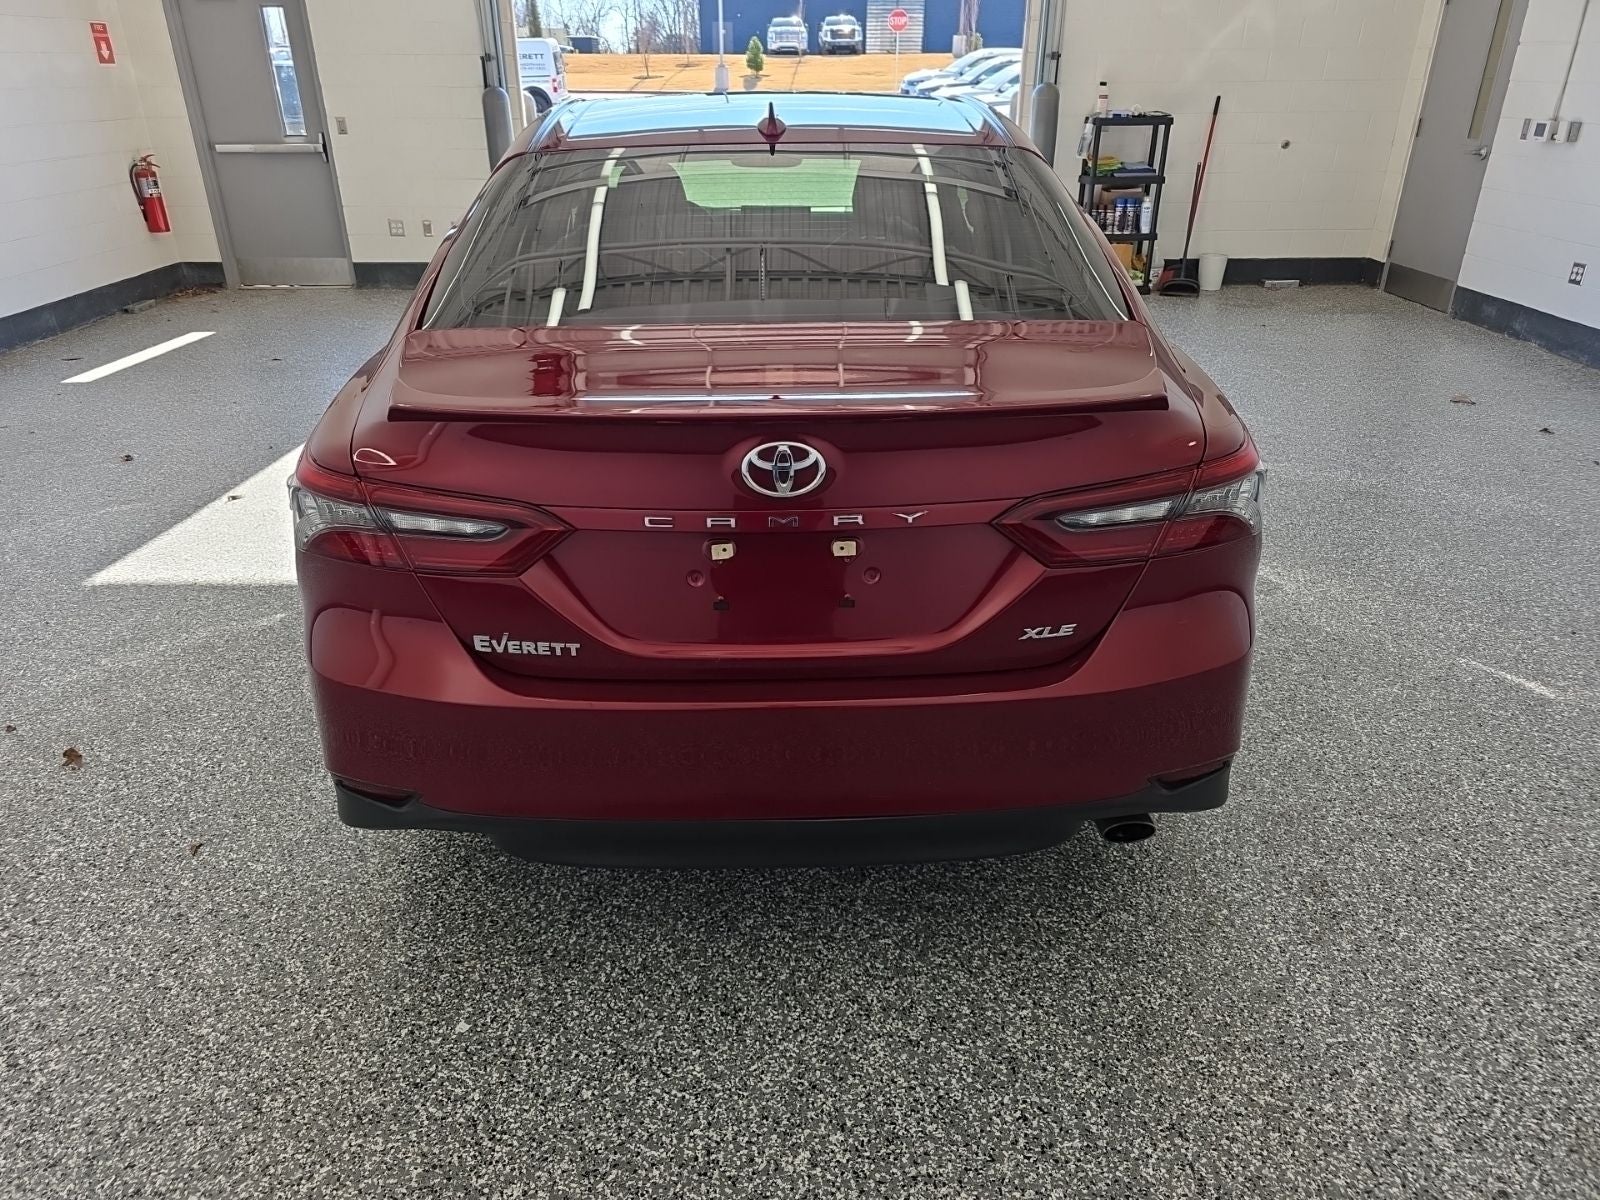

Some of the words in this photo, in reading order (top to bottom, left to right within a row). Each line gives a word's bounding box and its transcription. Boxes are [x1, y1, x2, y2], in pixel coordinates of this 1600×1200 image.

[889, 16, 907, 26] STOP
[643, 510, 929, 529] CAMRY
[1018, 623, 1077, 641] XLE
[472, 632, 581, 657] EVERETT
